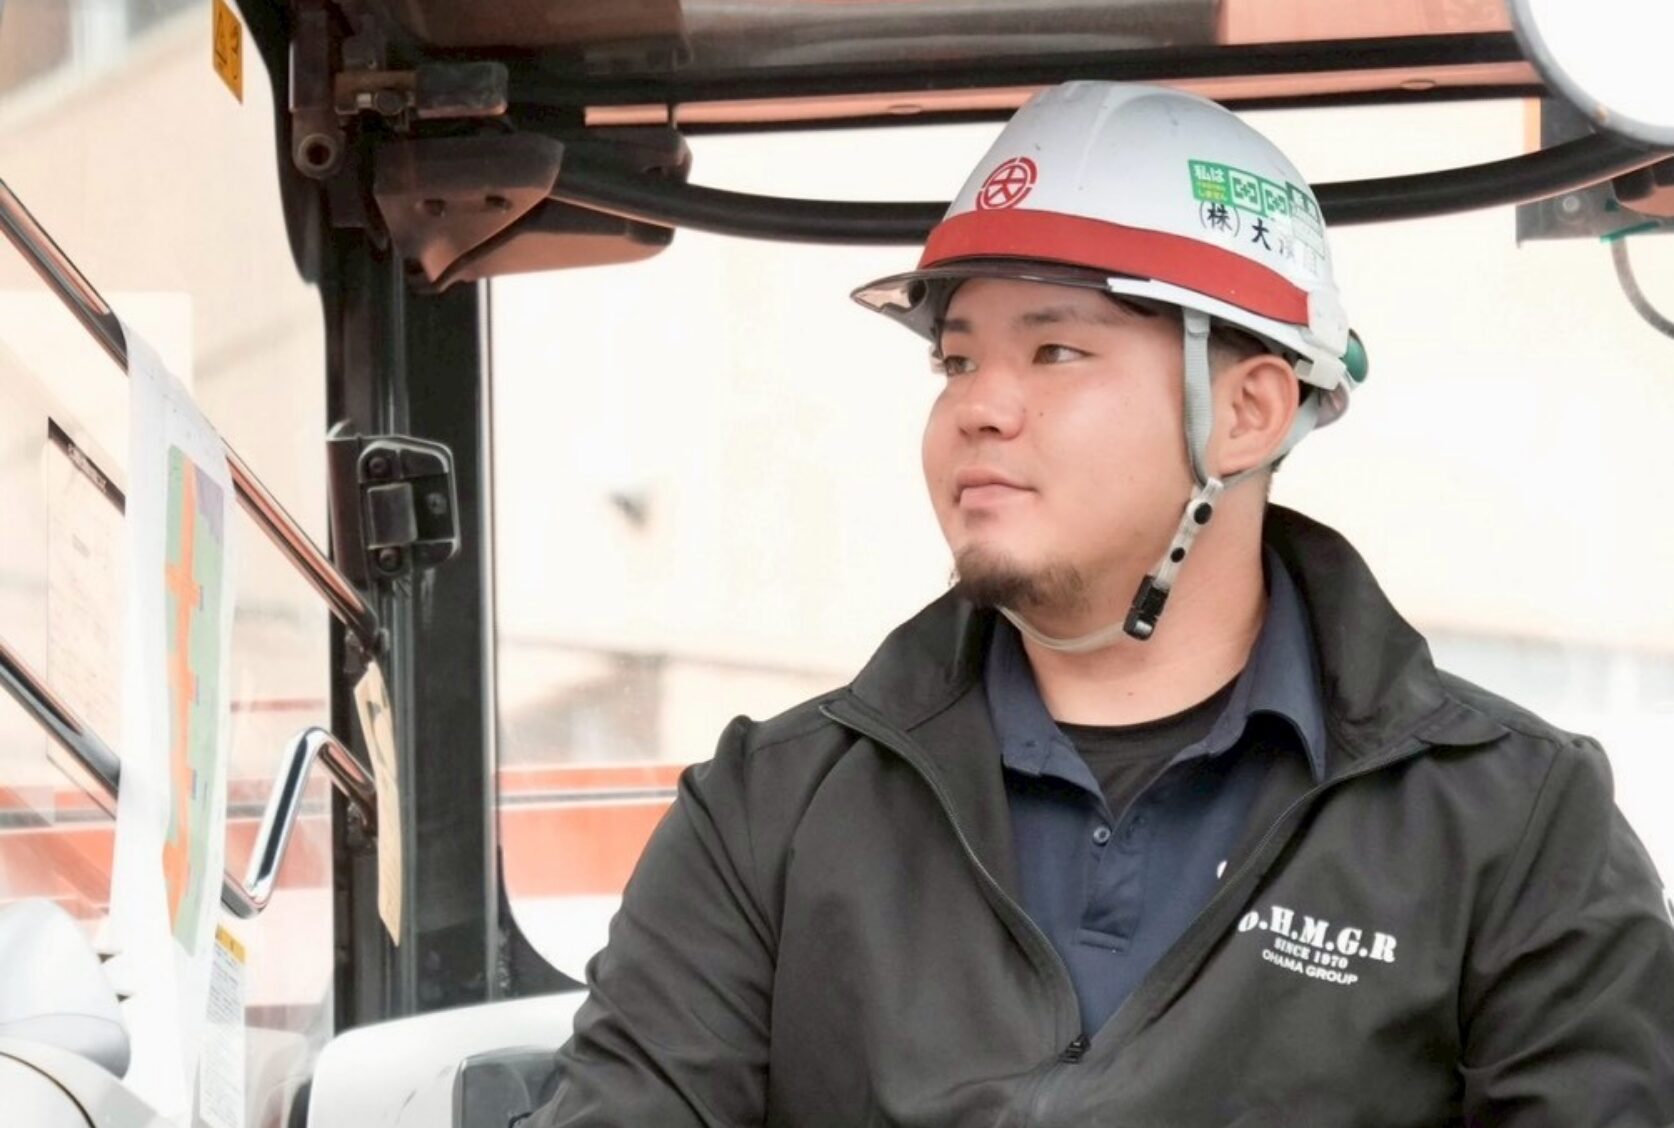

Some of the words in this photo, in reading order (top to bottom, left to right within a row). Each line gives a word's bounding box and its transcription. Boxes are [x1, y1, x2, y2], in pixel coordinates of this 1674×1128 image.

[1192, 164, 1226, 183] 私は
[1262, 949, 1303, 973] OHAMA
[1305, 964, 1358, 985] GROUP
[1274, 937, 1311, 960] SINCE
[1313, 951, 1349, 969] 1970
